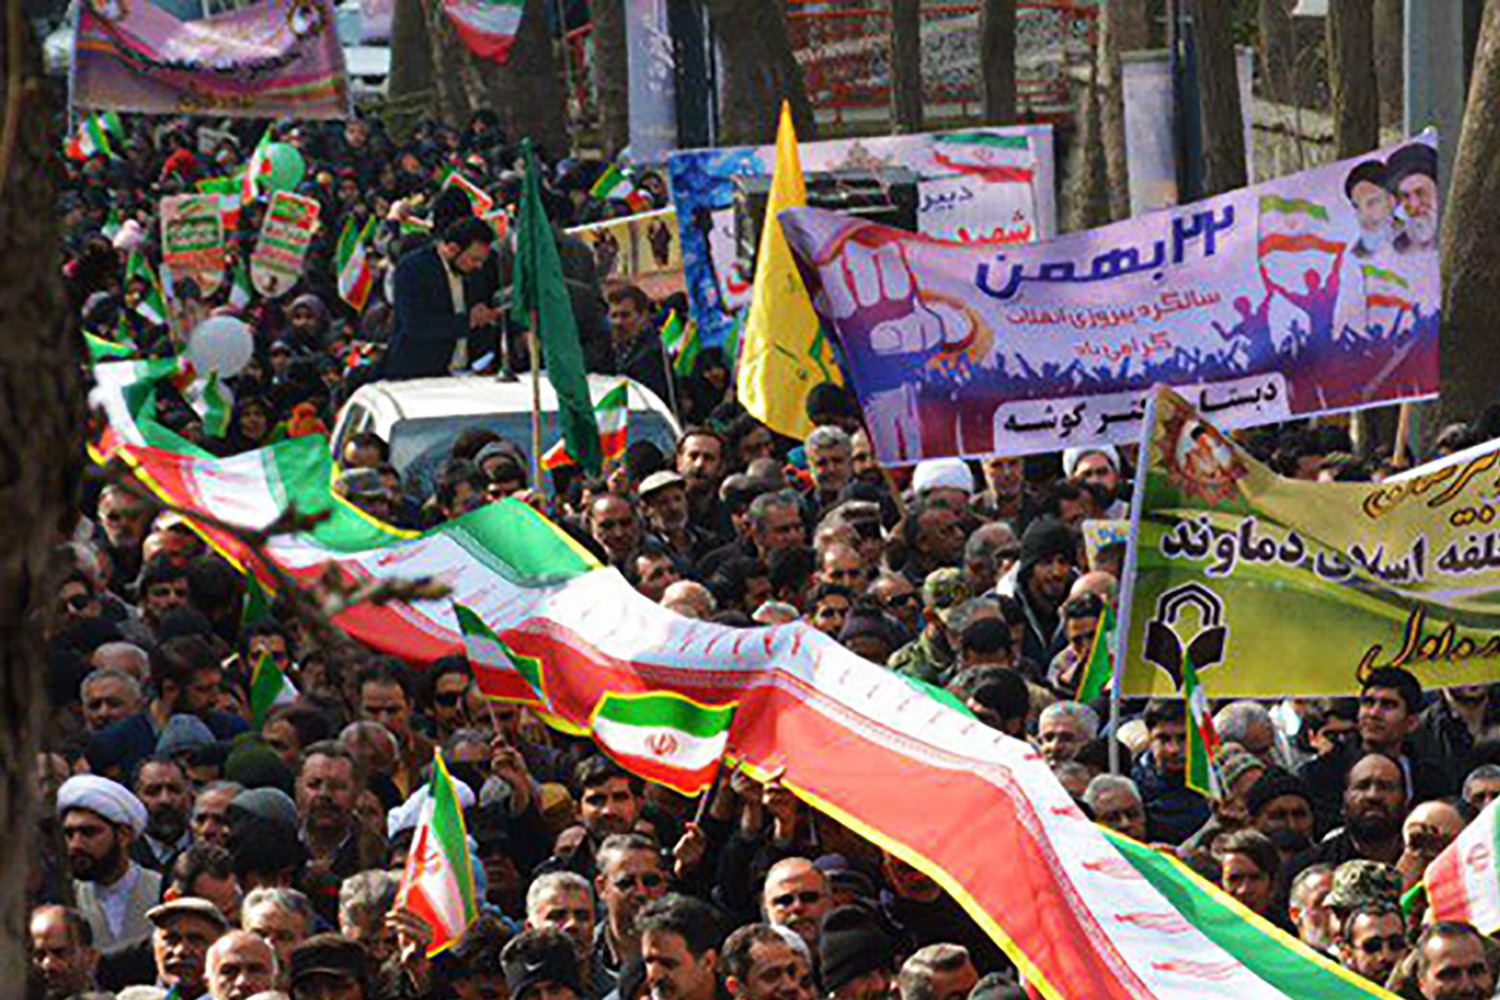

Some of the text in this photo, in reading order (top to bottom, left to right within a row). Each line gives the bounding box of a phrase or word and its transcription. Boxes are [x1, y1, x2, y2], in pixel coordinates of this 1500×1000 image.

[975, 205, 1235, 299] ۲۲ بهمن
[1070, 307, 1137, 332] پیروزی
[1199, 380, 1279, 413] دبستا
[1160, 514, 1307, 578] دماوند
